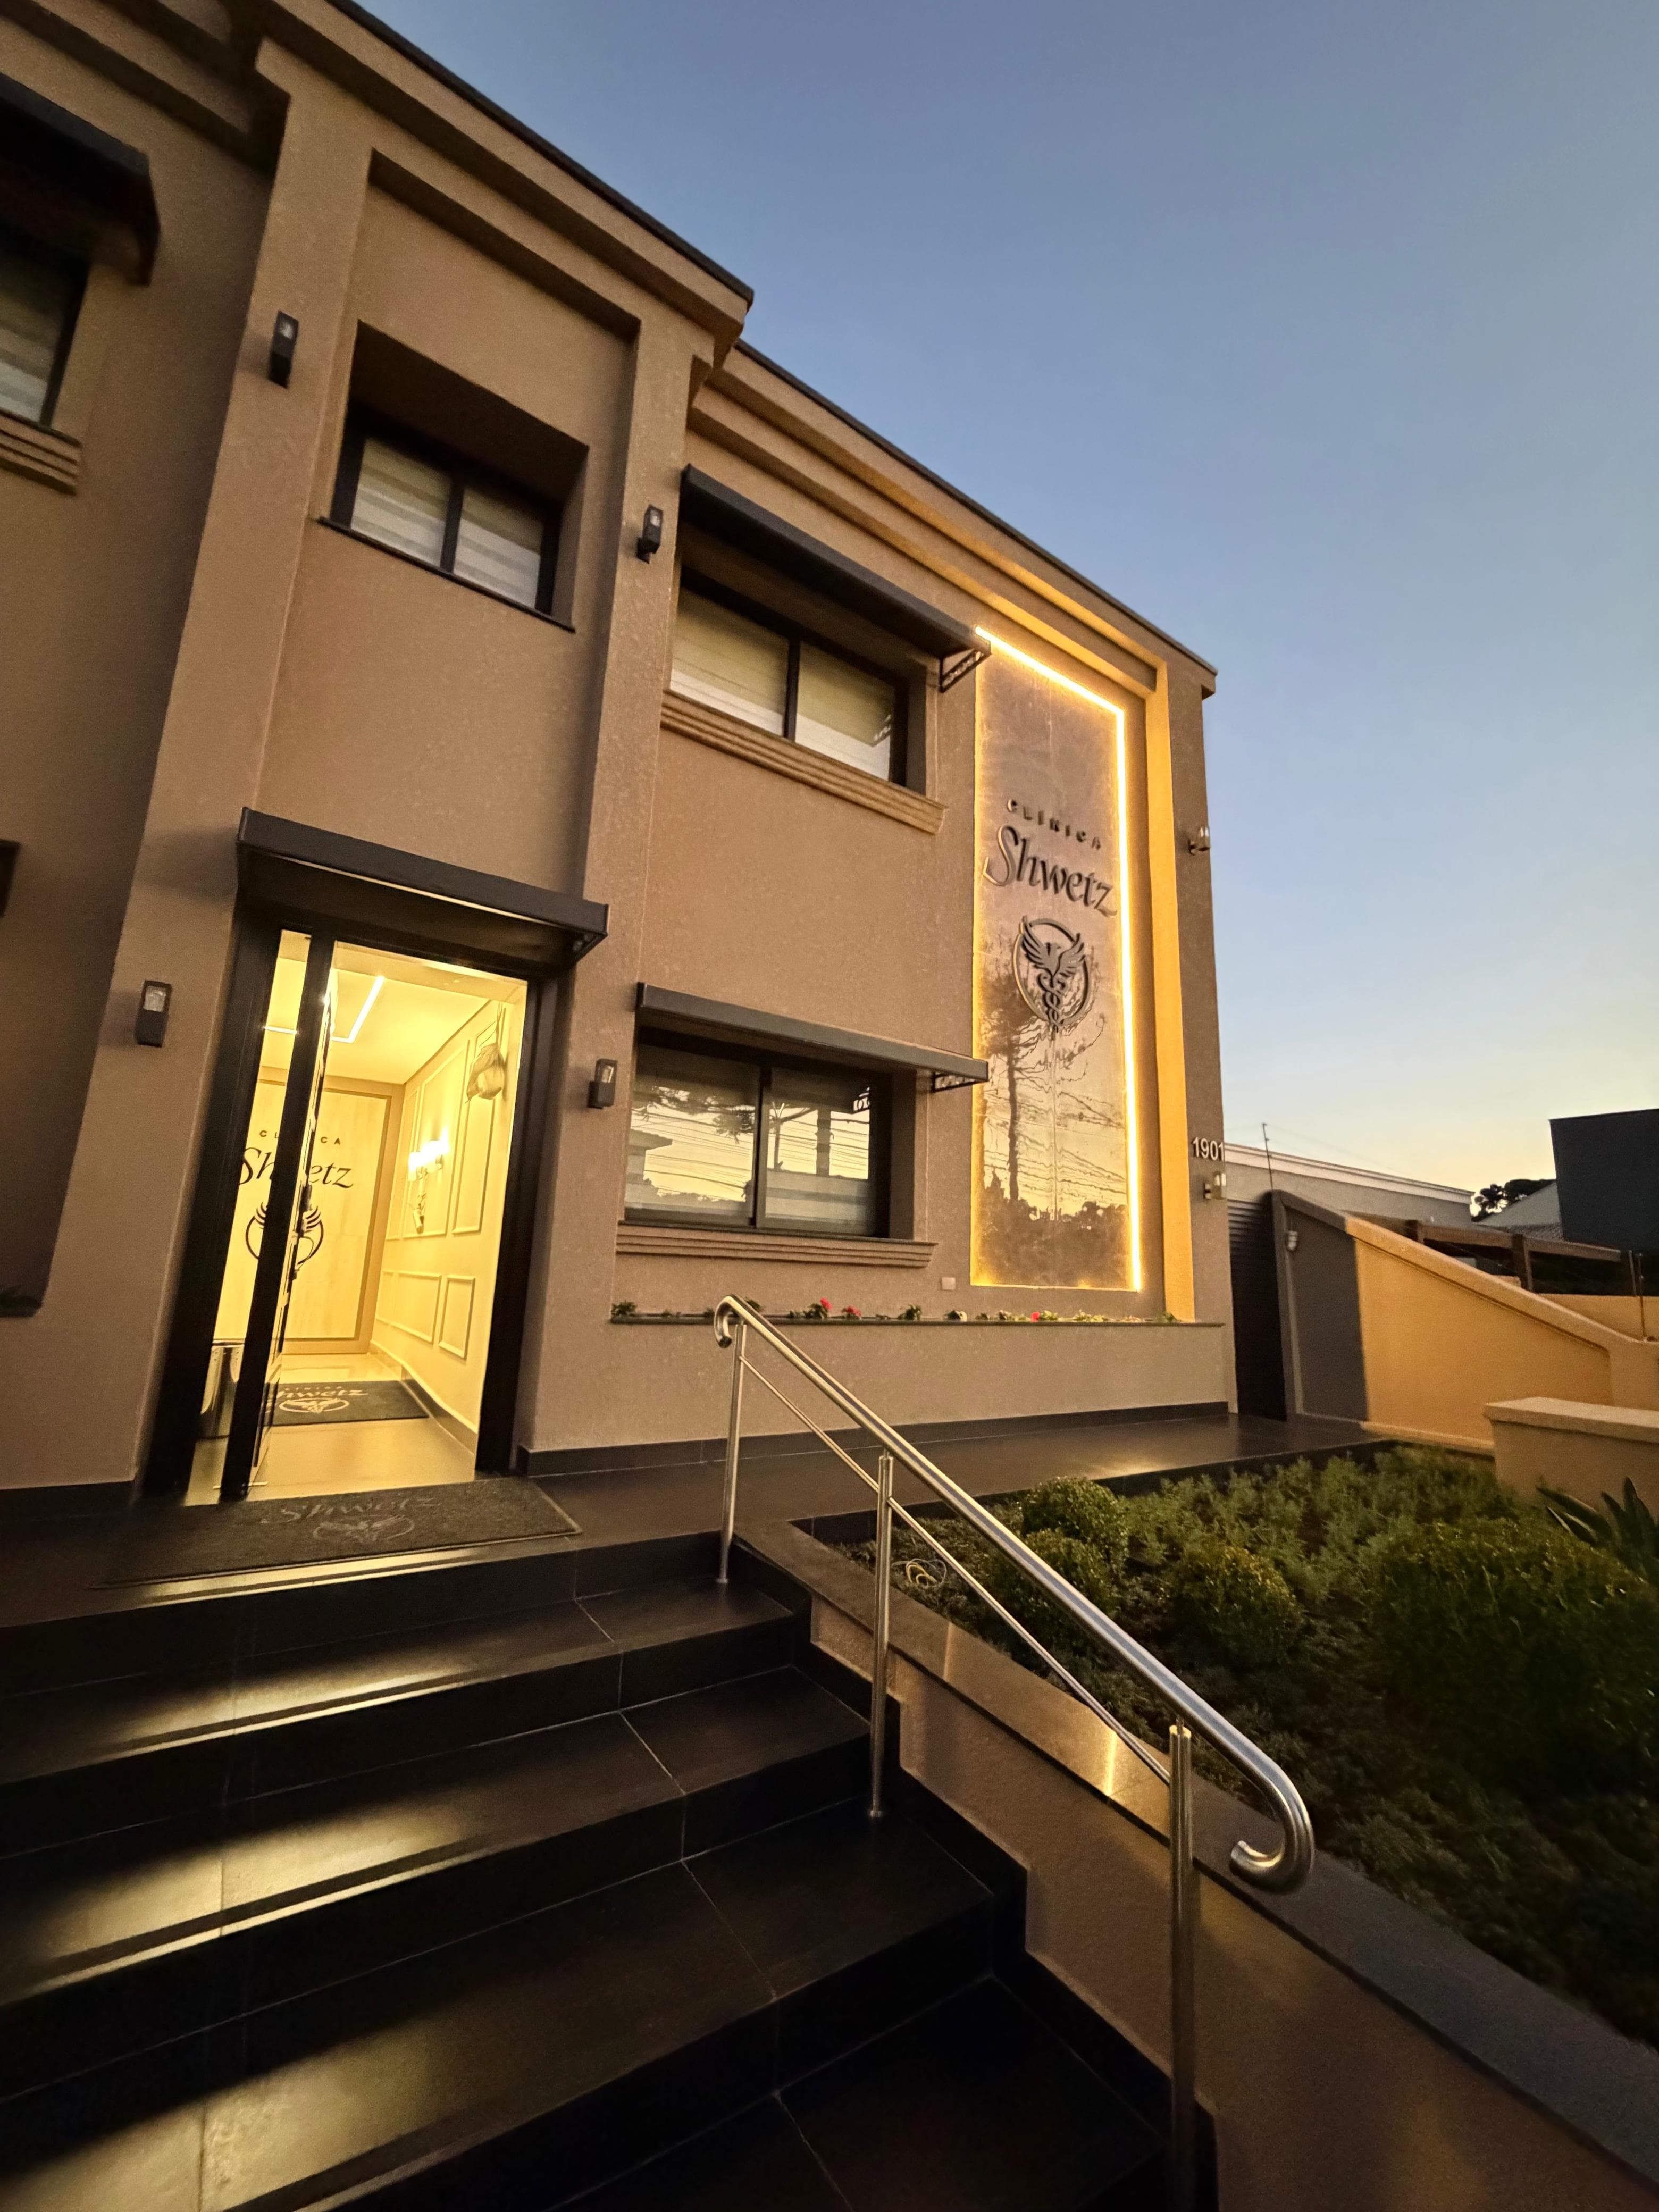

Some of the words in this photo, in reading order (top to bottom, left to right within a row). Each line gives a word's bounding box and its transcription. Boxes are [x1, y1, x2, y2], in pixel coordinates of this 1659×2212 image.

[983, 824, 1117, 917] Shwetz
[239, 1147, 354, 1189] Shetz
[1192, 1136, 1224, 1161] 1901
